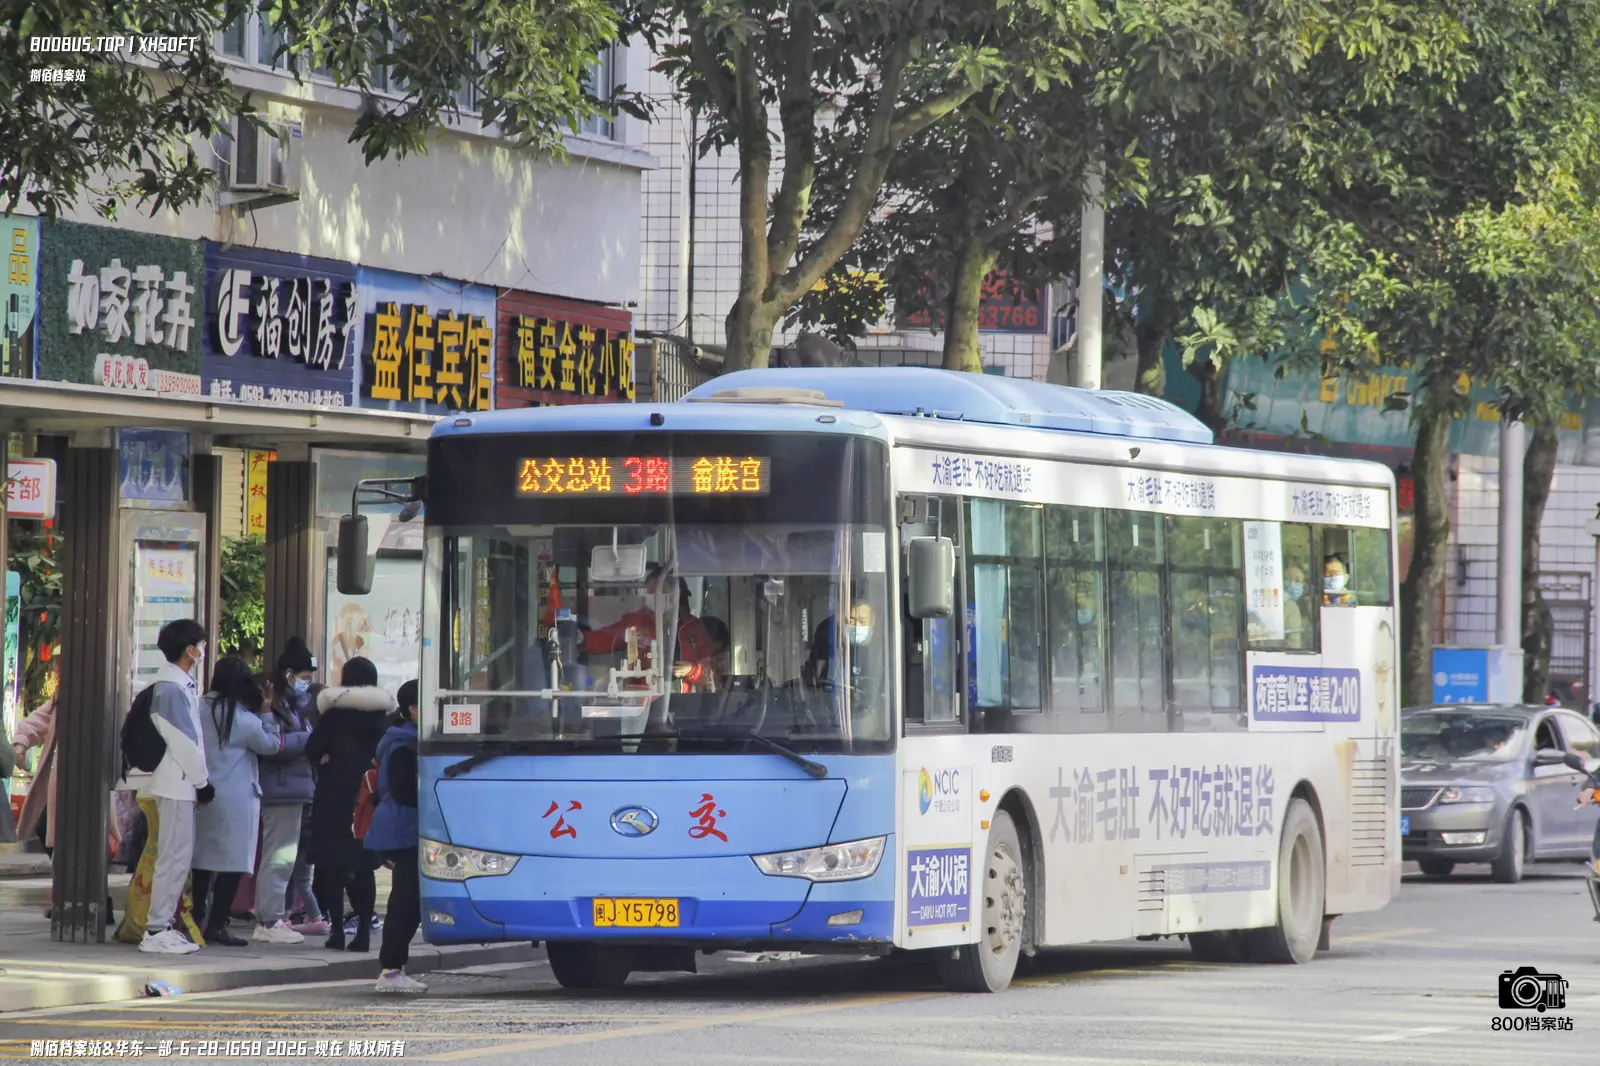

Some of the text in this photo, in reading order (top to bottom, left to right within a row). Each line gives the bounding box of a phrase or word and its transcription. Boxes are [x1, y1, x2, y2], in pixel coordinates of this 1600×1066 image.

[67, 258, 195, 352] 如家花卉
[103, 359, 147, 386] 鲜花批发
[371, 303, 492, 411] 盛佳宾馆
[517, 314, 636, 399] 福安金花小吃
[520, 457, 612, 493] 公交总站
[623, 456, 670, 493] 3路
[932, 455, 1033, 493] 大渝毛肚 不好吃就退货
[1256, 674, 1359, 714] 夜宵营业至 凌晨2:00
[450, 711, 473, 727] 3路
[934, 770, 960, 796] NCIC
[542, 793, 729, 843] 公 交
[1049, 764, 1275, 844] 大渝毛肚 不好吃就退货
[911, 855, 968, 898] 大渝火锅
[920, 903, 957, 920] DAYU HOT POT
